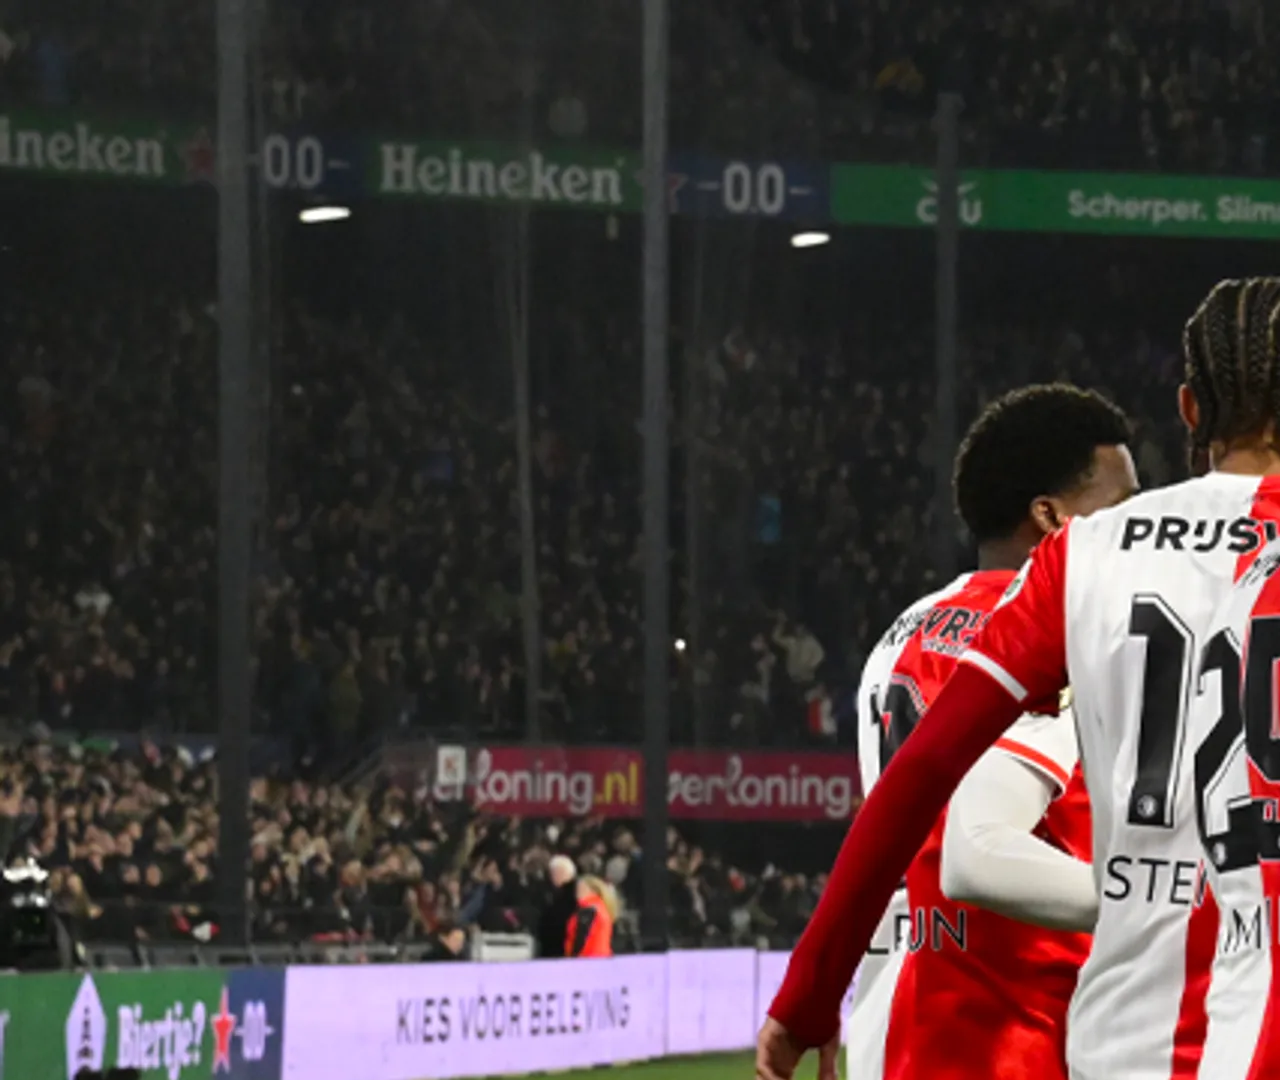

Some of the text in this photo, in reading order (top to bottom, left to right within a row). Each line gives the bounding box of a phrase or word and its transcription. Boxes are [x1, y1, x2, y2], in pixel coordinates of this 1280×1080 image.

[379, 143, 623, 203] Heineken
[916, 197, 982, 225] CU
[1067, 189, 1207, 226] Scherper.
[396, 986, 630, 1044] KIES VOOR BELEVING
